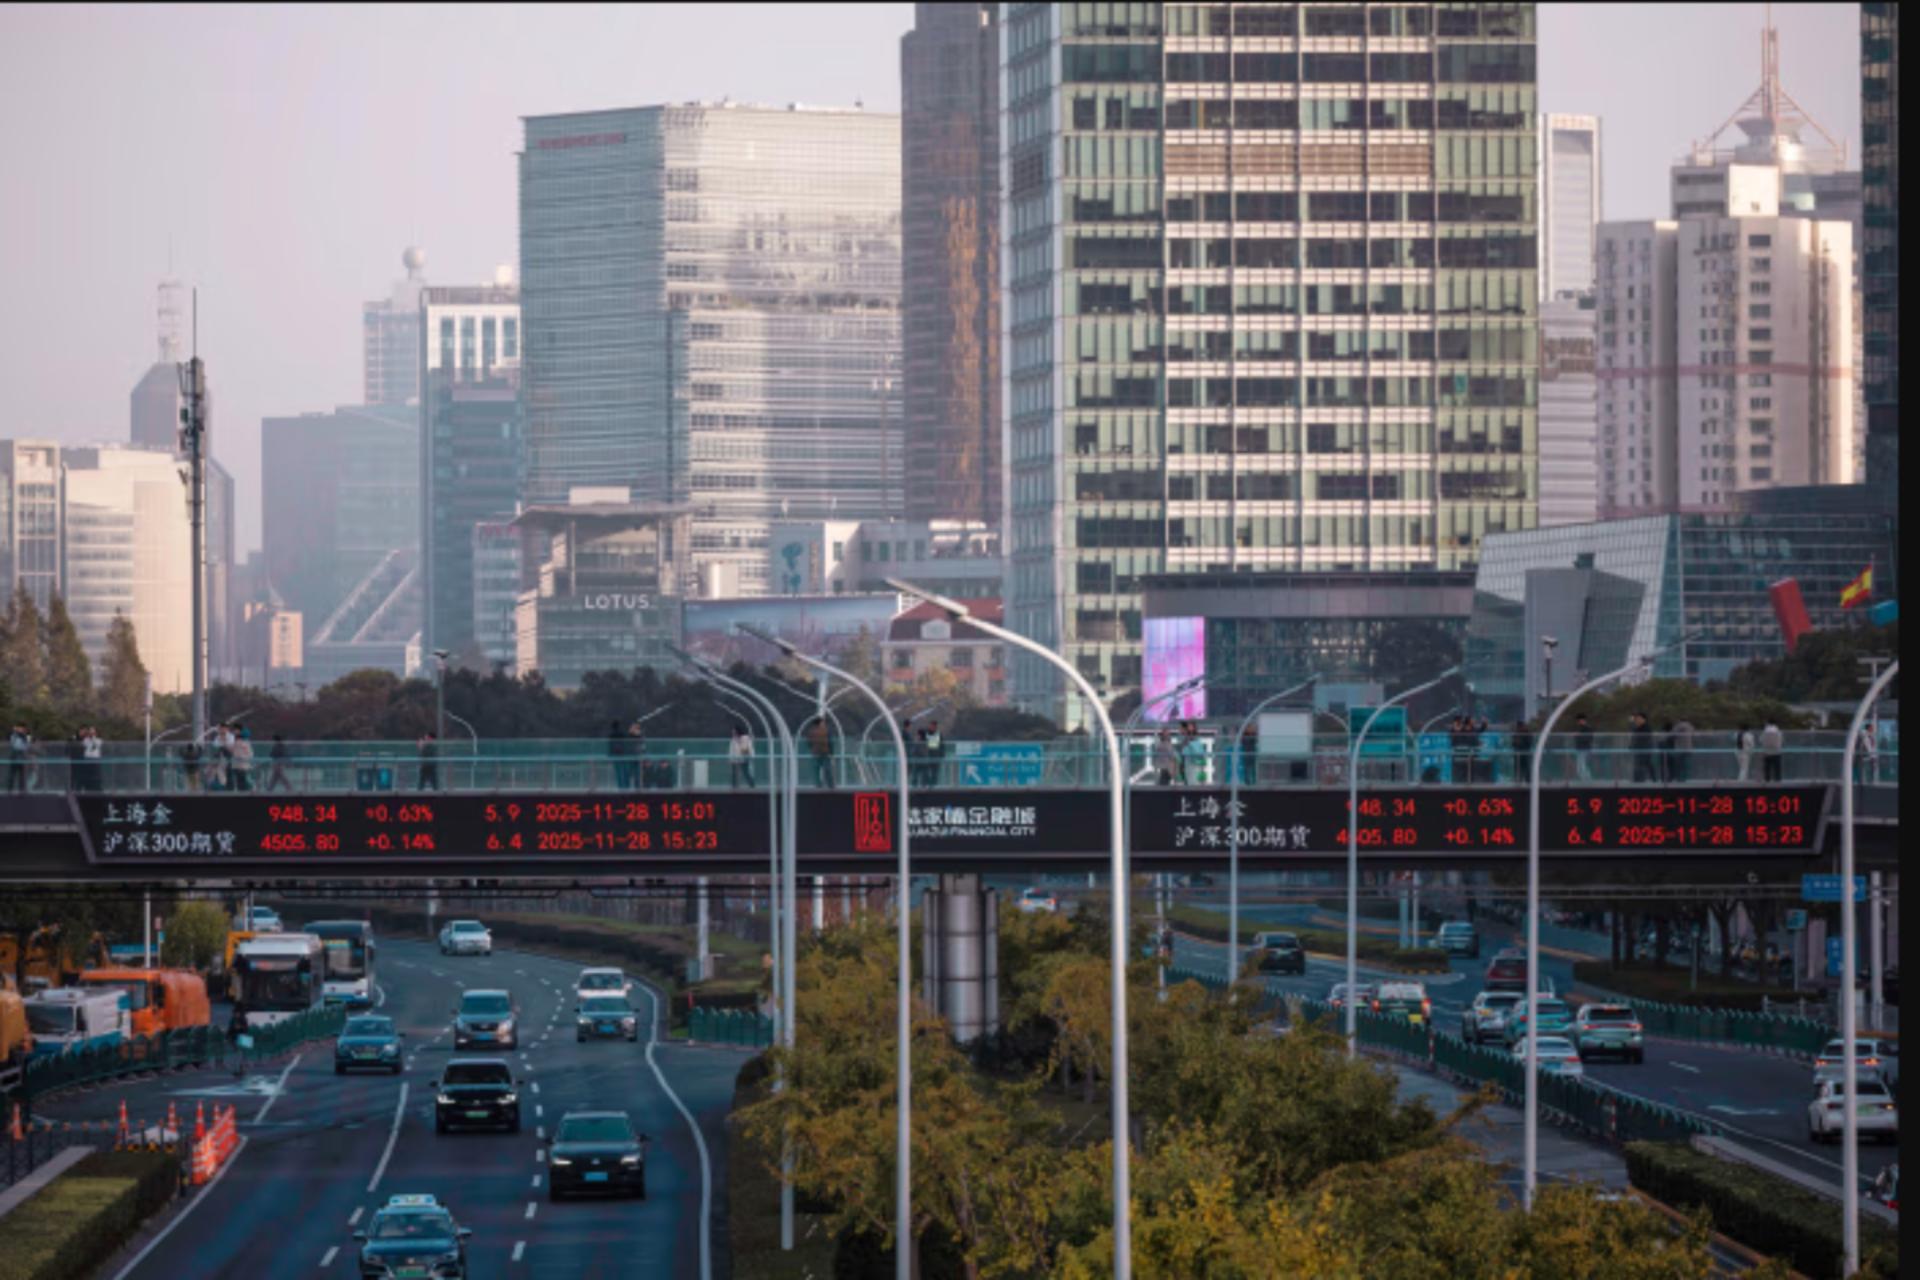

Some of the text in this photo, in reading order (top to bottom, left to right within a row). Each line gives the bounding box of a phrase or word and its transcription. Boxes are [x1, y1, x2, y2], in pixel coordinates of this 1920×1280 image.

[584, 593, 650, 610] LOTUS
[102, 802, 173, 826] 上海金
[267, 804, 337, 823] 948.34
[535, 804, 650, 821] 2025-11-28
[661, 803, 714, 820] 15:01
[1444, 798, 1515, 816] +0.63%
[1618, 798, 1733, 815] 2025-11-28
[1745, 797, 1801, 813] 15:01
[260, 832, 339, 852] 4505.80
[366, 833, 436, 851] +0.14%
[537, 832, 651, 850] 2025-11-28
[664, 831, 718, 849] 15:23
[1336, 828, 1418, 845] 405.80
[1445, 827, 1516, 845] +0.14%
[1618, 827, 1734, 845] 2025-11-28
[1745, 825, 1804, 843] 15:23
